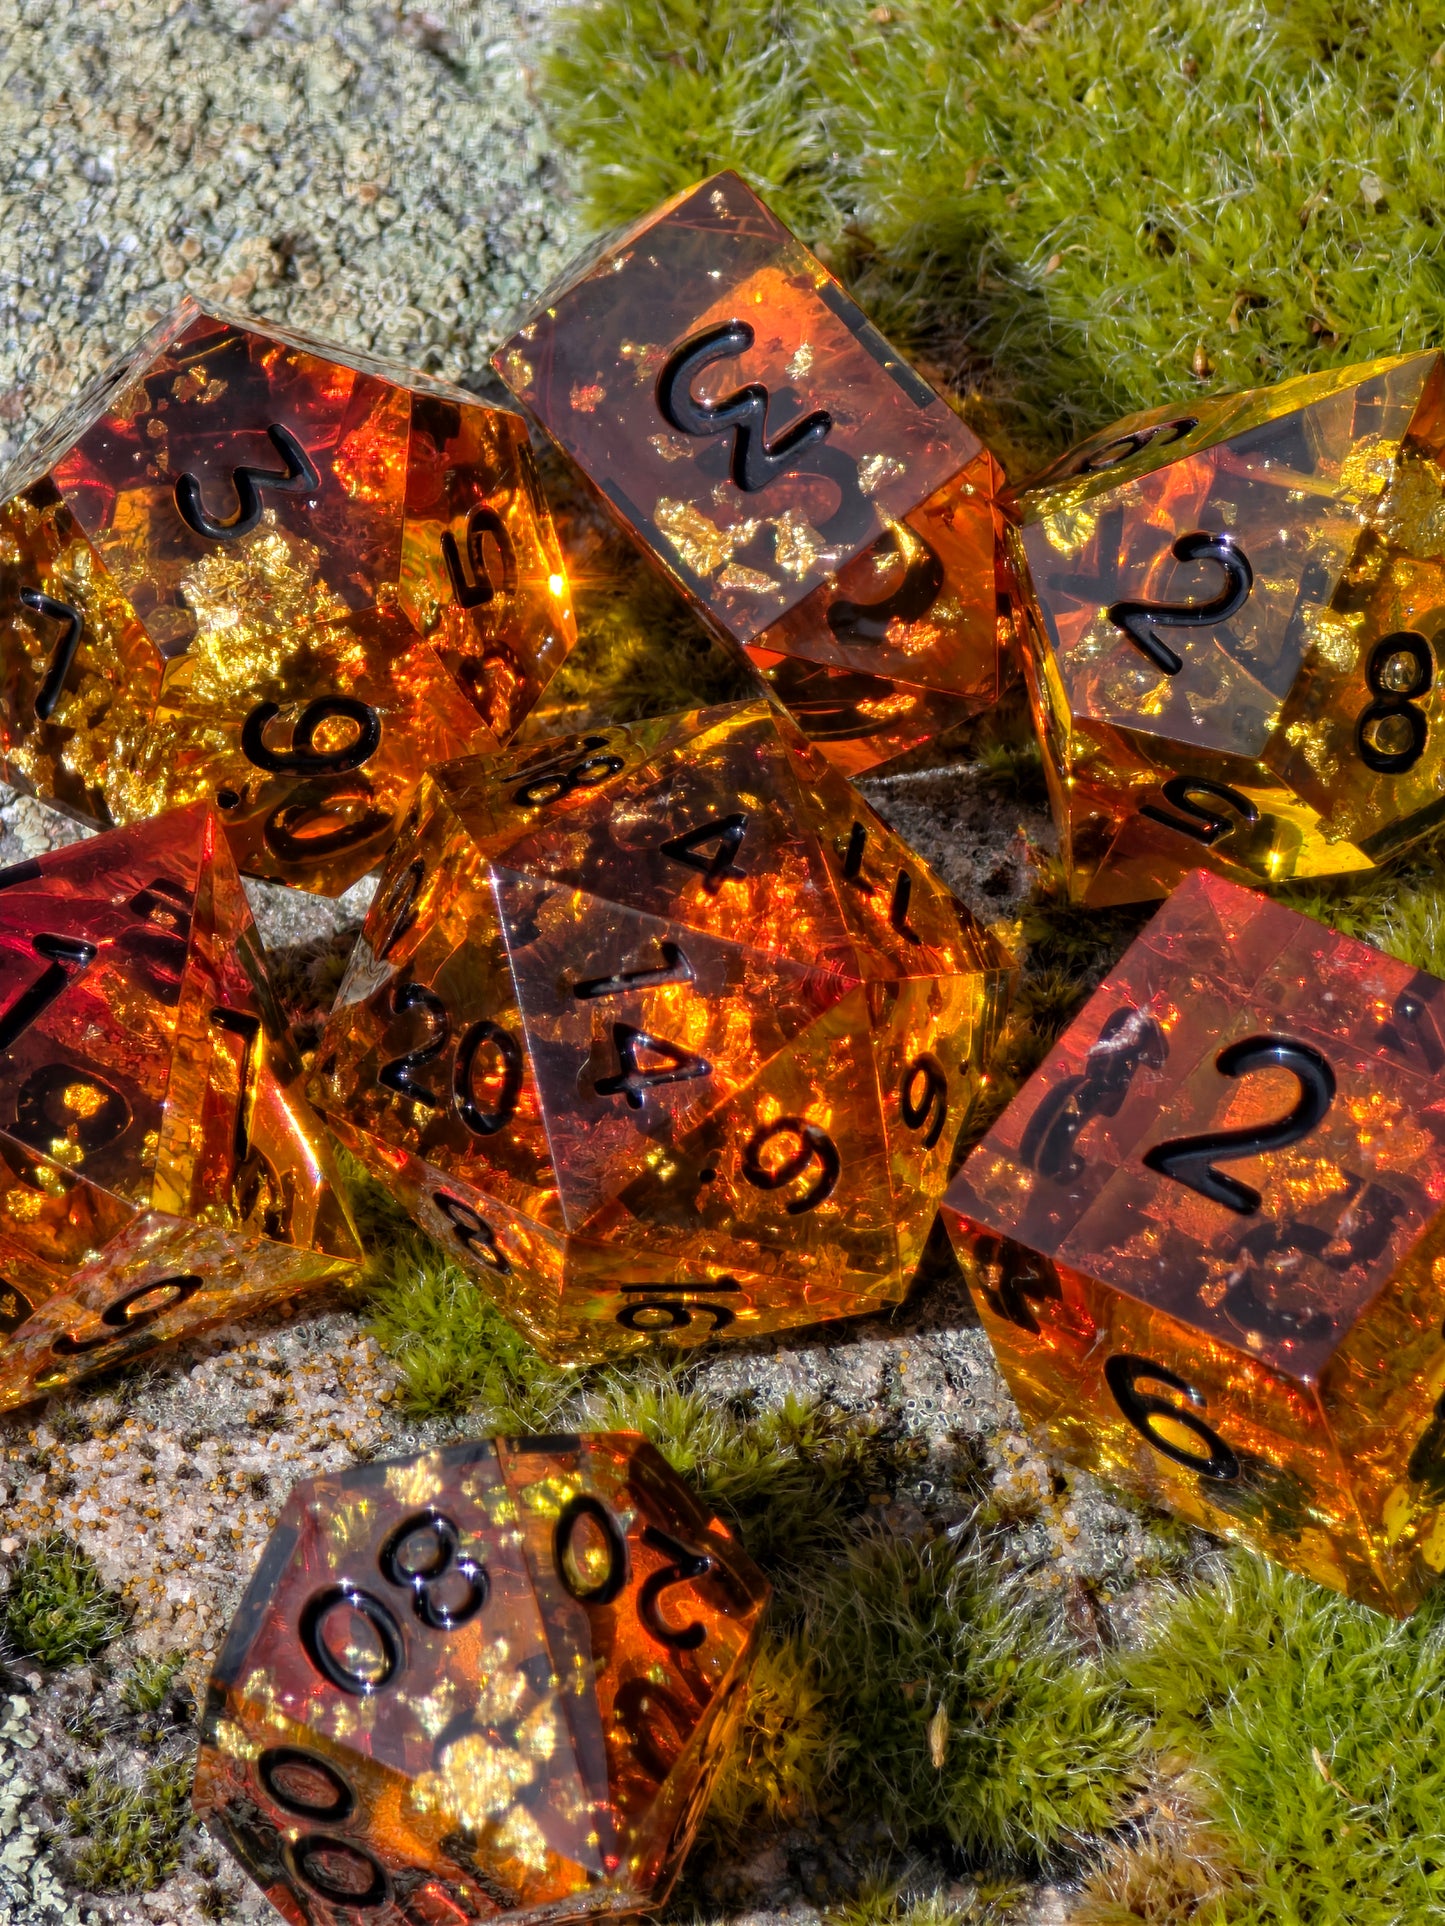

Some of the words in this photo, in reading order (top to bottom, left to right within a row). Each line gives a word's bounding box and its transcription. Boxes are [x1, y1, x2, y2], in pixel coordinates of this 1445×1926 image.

[655, 318, 832, 493] 3
[174, 423, 321, 541] 3
[440, 504, 519, 609] 5
[1108, 530, 1254, 676] 2
[18, 586, 83, 720] 7
[1354, 631, 1438, 775] 8
[658, 813, 748, 899] 4
[378, 982, 526, 1136] 20
[1143, 1034, 1338, 1216] 2
